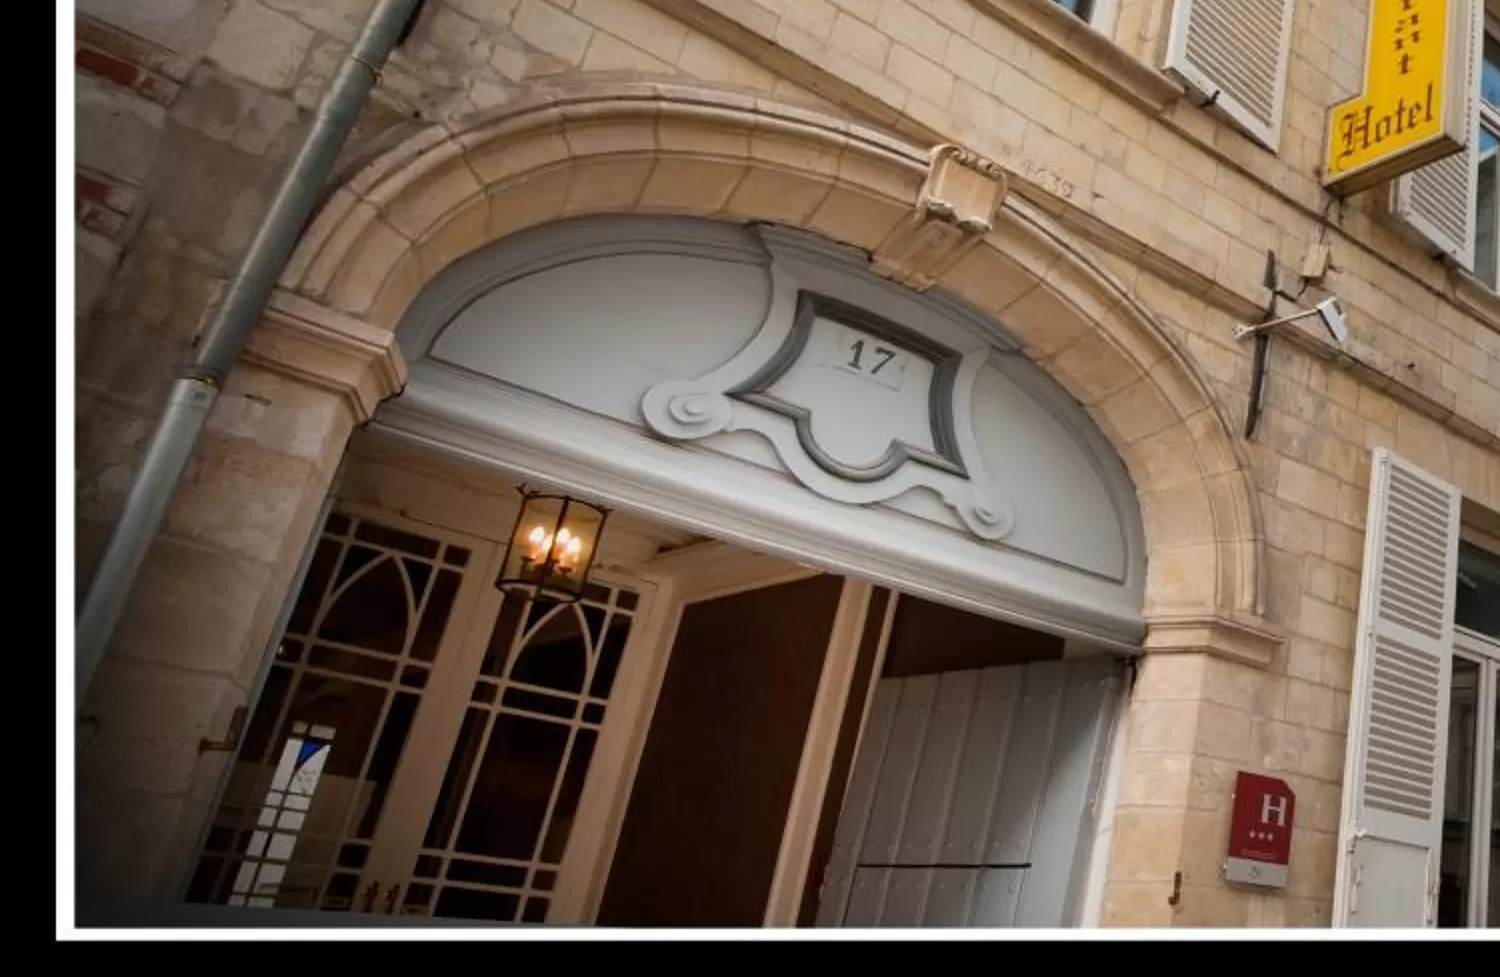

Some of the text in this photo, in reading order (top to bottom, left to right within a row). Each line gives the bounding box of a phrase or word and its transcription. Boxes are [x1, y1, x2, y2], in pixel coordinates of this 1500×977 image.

[1337, 79, 1434, 169] Hotel
[848, 339, 897, 375] 17
[1261, 793, 1288, 827] H
